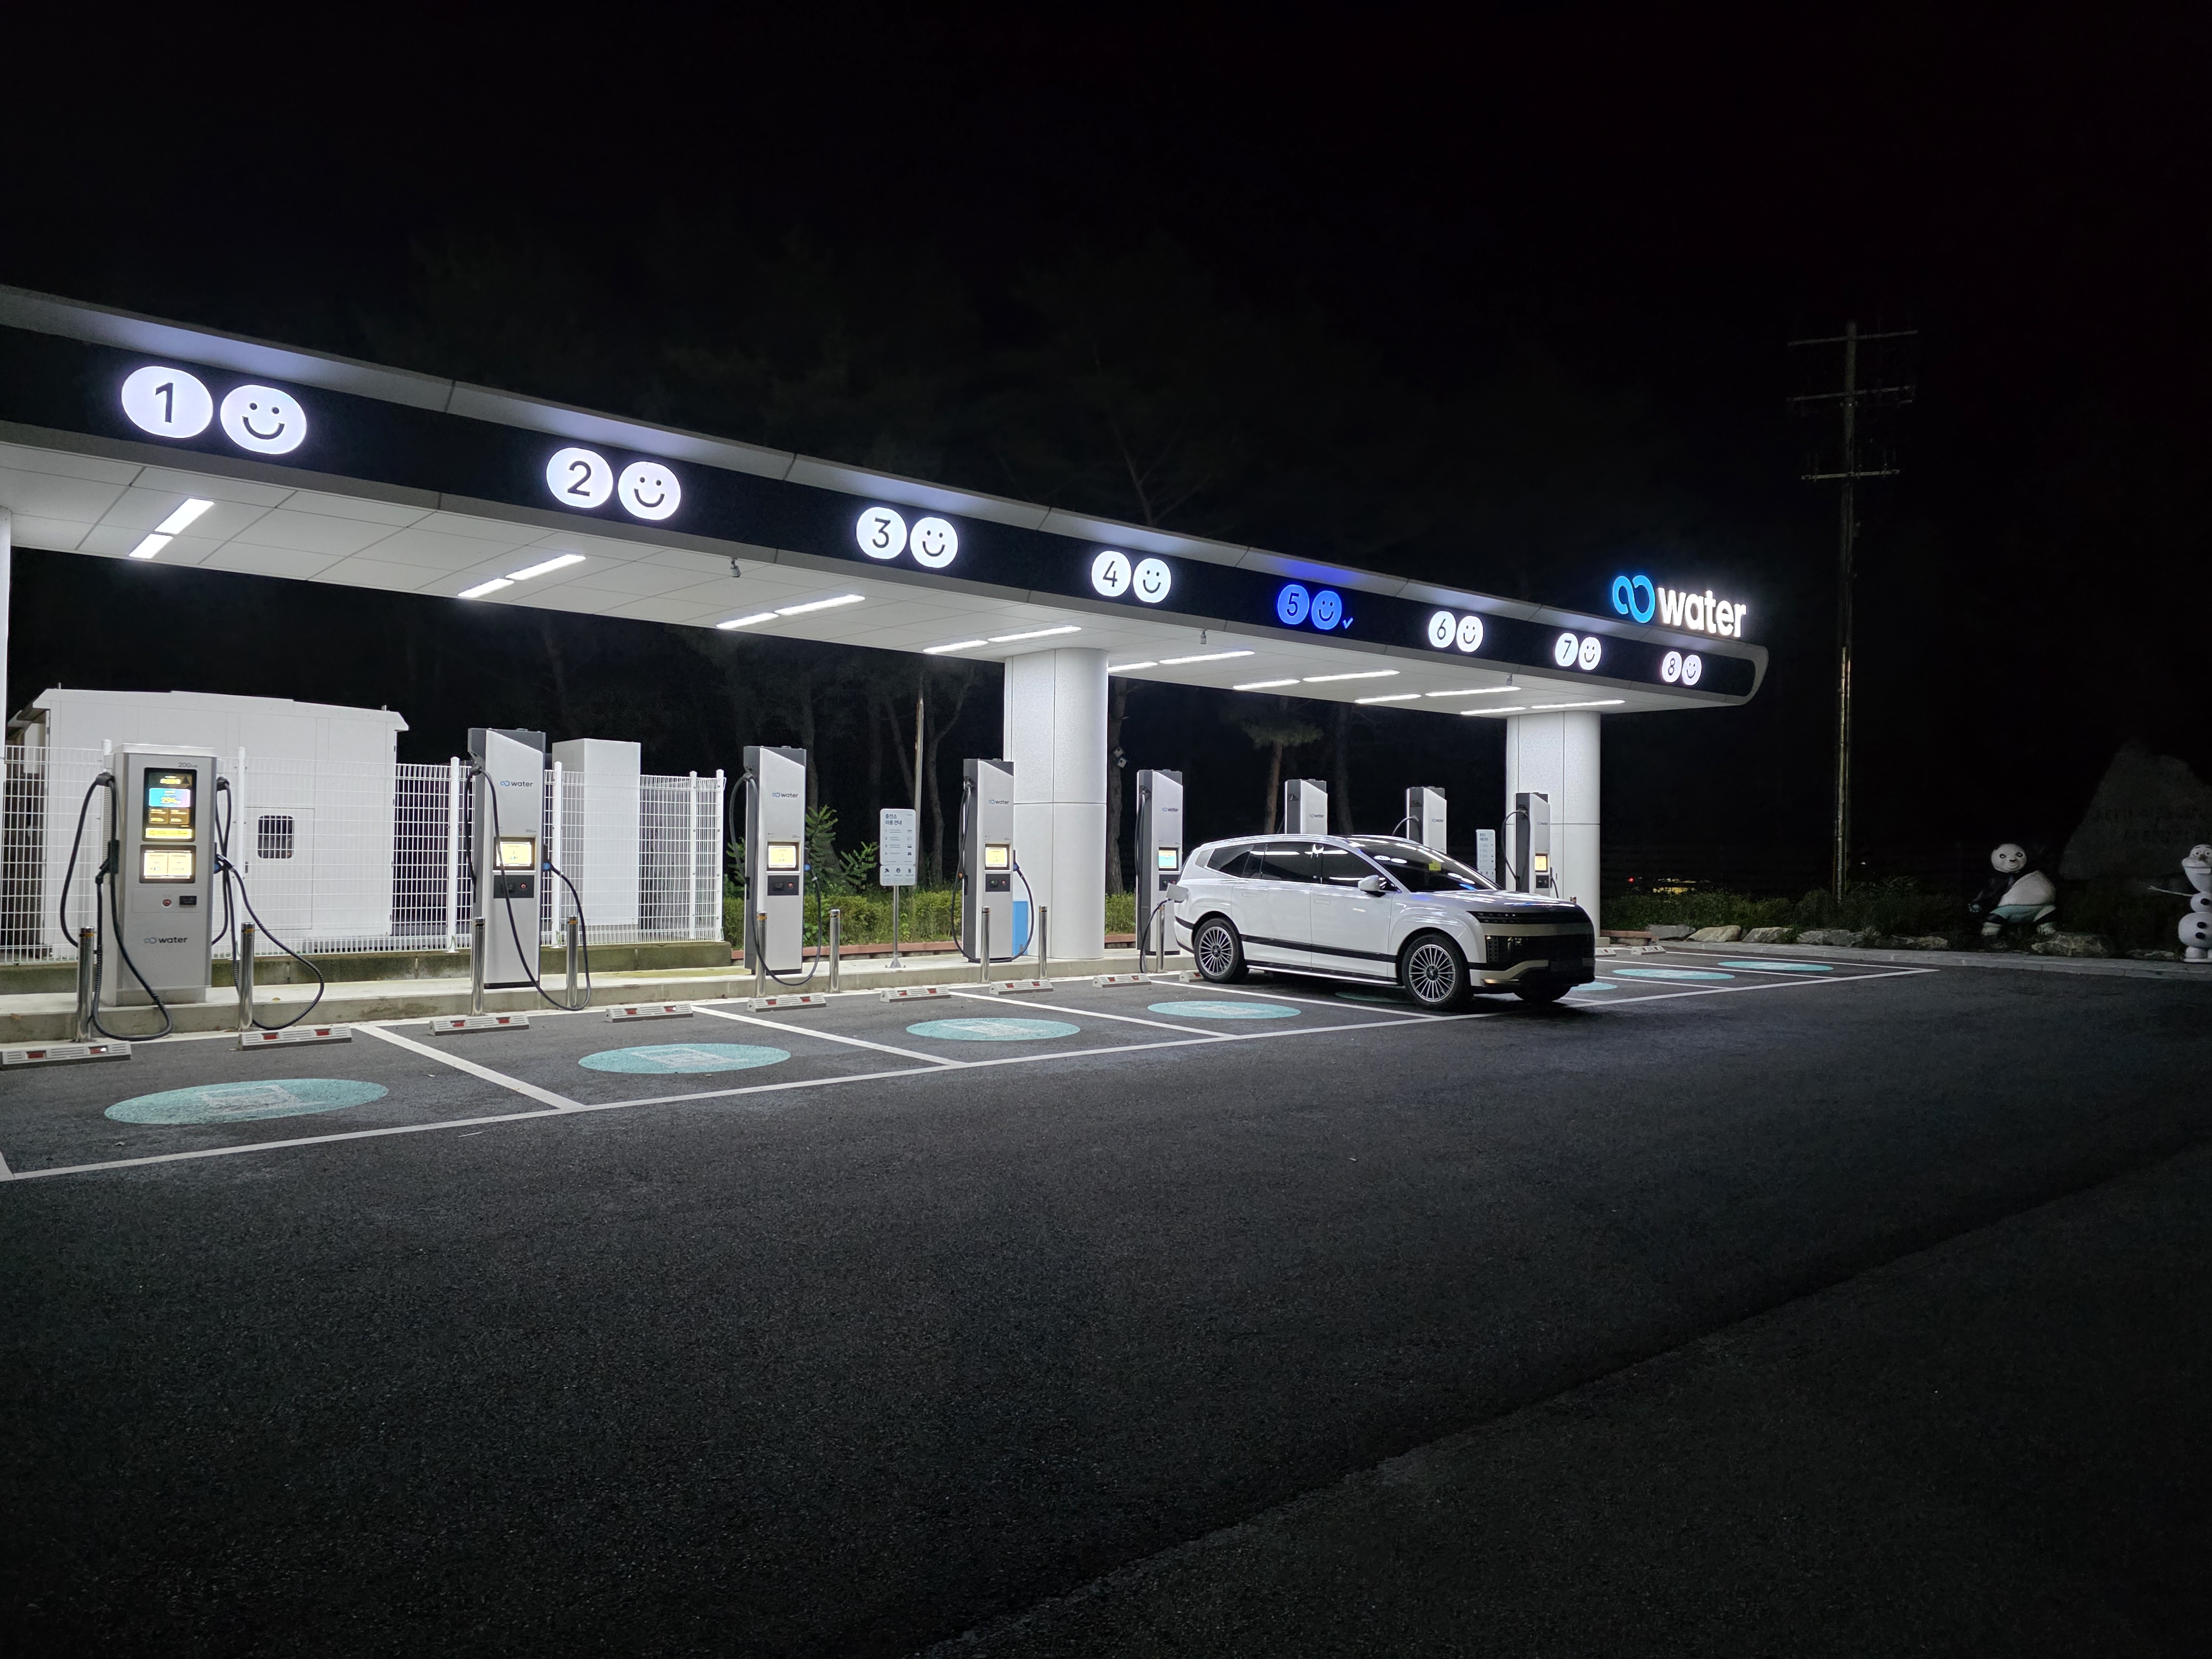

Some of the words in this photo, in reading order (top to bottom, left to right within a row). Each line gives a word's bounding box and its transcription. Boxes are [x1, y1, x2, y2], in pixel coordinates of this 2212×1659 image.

[155, 382, 174, 423] 1
[567, 460, 592, 497] 2
[872, 517, 891, 548] 3
[1103, 560, 1118, 588] 4
[1287, 592, 1300, 617] 5
[1657, 587, 1747, 638] water
[1437, 618, 1447, 640] 6
[1563, 639, 1572, 659] 7
[1668, 658, 1676, 676] 8
